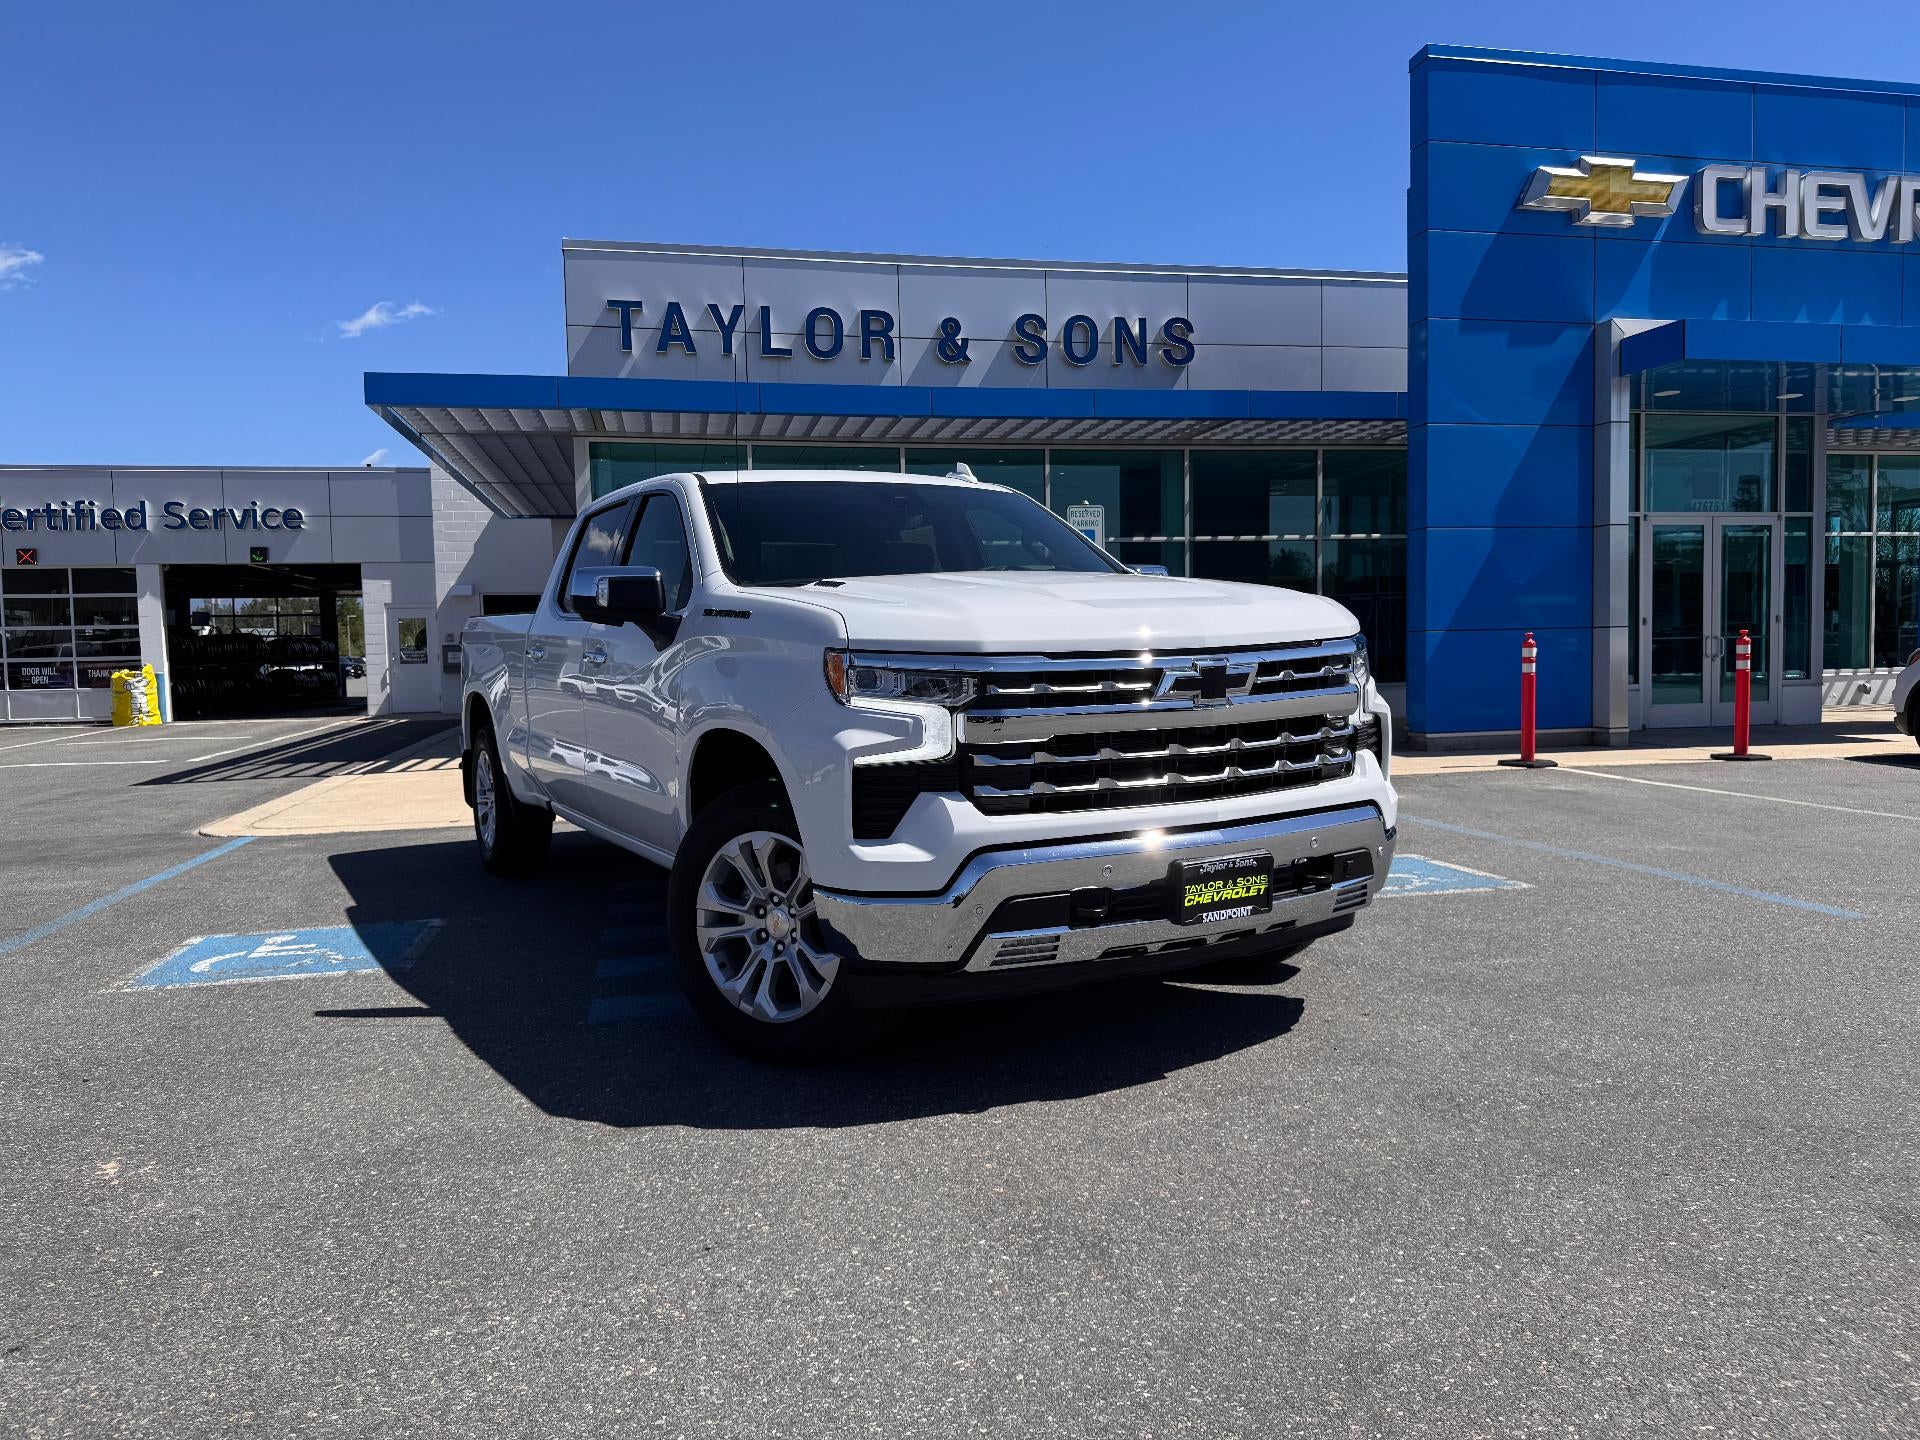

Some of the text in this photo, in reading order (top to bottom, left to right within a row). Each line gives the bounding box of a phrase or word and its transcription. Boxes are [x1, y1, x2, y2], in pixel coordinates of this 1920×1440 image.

[606, 300, 1196, 367] TAYLOR & SONS
[0, 500, 304, 531] ertified Service
[1070, 510, 1101, 518] RESERVED
[1073, 519, 1099, 527] PARKING
[21, 666, 58, 676] DOOR WILL
[87, 669, 110, 678] THANK
[31, 676, 49, 685] OPEN
[1202, 862, 1227, 873] Taylor
[1235, 859, 1254, 868] Sons
[1184, 874, 1268, 894] TAYLOR & SONS
[1184, 885, 1268, 907] CHEVROLET
[1202, 906, 1253, 923] SANDPOINT
